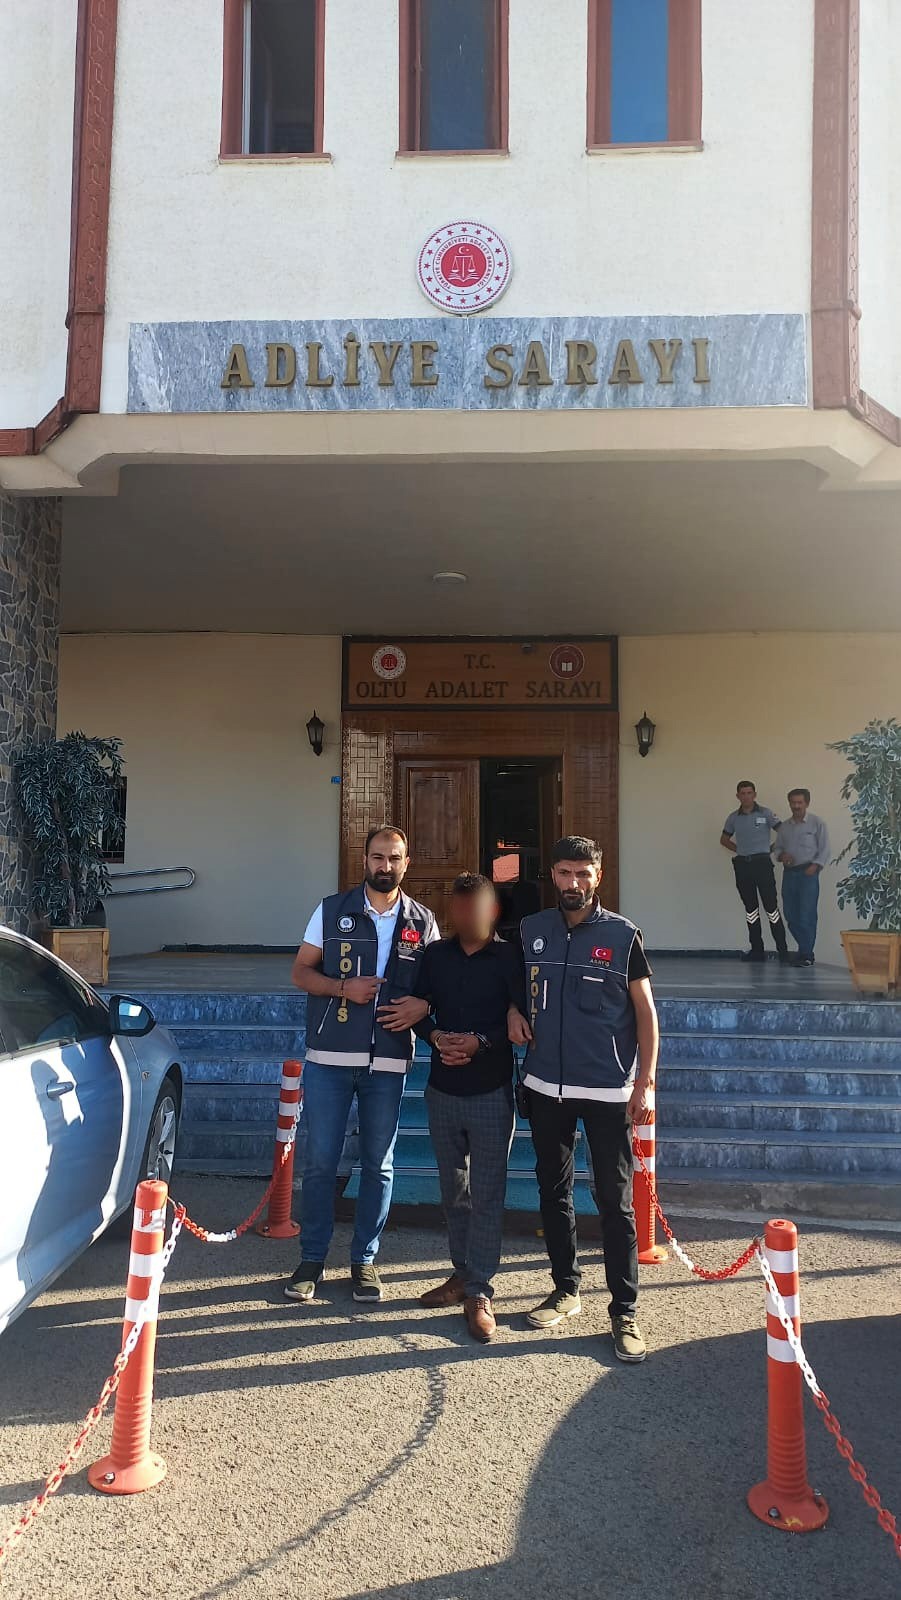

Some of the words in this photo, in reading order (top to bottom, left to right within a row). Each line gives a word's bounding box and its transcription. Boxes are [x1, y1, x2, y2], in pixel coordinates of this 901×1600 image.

[220, 332, 439, 388] ADLİYE
[483, 337, 712, 388] SARAYI
[464, 654, 495, 670] T.C.
[356, 681, 407, 698] OLTU
[425, 681, 508, 698] ADALET
[526, 681, 601, 698] SARAYI
